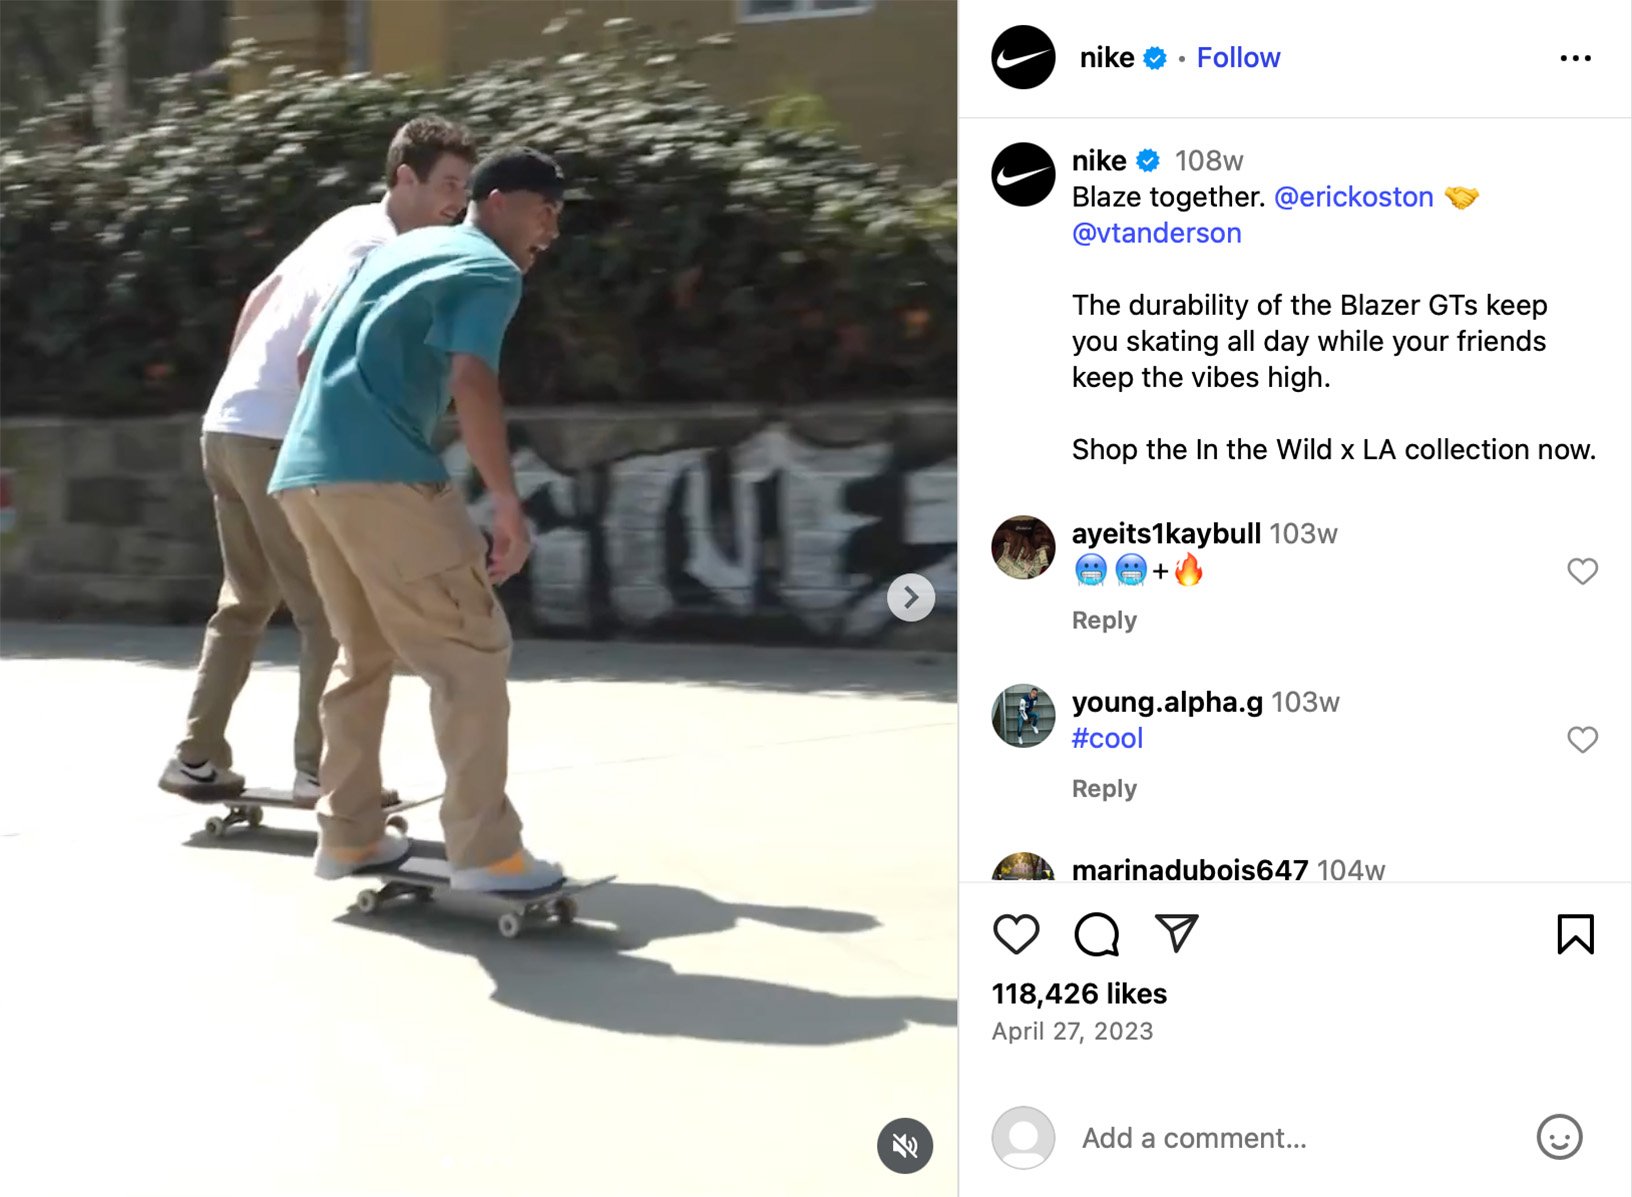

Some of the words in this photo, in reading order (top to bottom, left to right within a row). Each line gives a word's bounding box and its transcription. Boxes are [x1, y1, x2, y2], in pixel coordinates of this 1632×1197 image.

[1081, 45, 1135, 68] nike
[1198, 46, 1281, 68] Follow
[1073, 148, 1127, 171] nike
[1176, 150, 1243, 171] 108w
[1073, 185, 1141, 207] Blaze
[1150, 185, 1264, 212] together.
[1275, 185, 1433, 210] @erickoston
[1073, 221, 1241, 246] @vtanderson
[1072, 293, 1120, 315] The
[1129, 293, 1249, 320] durability
[1258, 293, 1282, 315] of
[1290, 293, 1331, 315] the
[1342, 293, 1421, 315] Blazer
[1429, 294, 1477, 316] GTs
[1487, 293, 1547, 320] keep
[1072, 335, 1117, 356] you
[1127, 329, 1218, 356] skating
[1228, 330, 1254, 351] all
[1264, 330, 1309, 356] day
[1318, 329, 1383, 351] while
[1392, 335, 1449, 356] your
[1457, 329, 1546, 351] friends
[1073, 366, 1133, 392] keep
[1142, 366, 1183, 388] the
[1192, 366, 1259, 388] vibes
[1269, 366, 1330, 392] high.
[1073, 438, 1137, 464] Shop
[1146, 438, 1187, 460] the
[1197, 439, 1217, 459] In
[1226, 438, 1267, 460] the
[1276, 438, 1331, 460] Wild
[1341, 444, 1354, 459] x
[1364, 439, 1396, 459] LA
[1405, 438, 1529, 460] collection
[1539, 443, 1595, 460] now.
[1072, 521, 1260, 549] ayeits1kaybull
[1270, 523, 1338, 544] 103w
[1073, 610, 1137, 633] Reply
[1072, 690, 1262, 717] young.alpha.g
[1273, 691, 1340, 712] 103w
[1072, 727, 1142, 748] #cool
[1073, 779, 1137, 802] Reply
[1073, 858, 1308, 880] marinadubois647
[1318, 859, 1385, 880] 104w
[993, 983, 1098, 1009] 118,426
[1108, 981, 1167, 1004] likes
[992, 1021, 1043, 1044] April
[1054, 1022, 1084, 1044] 27,
[1095, 1022, 1153, 1040] 2023
[1083, 1127, 1132, 1148] Add
[1142, 1132, 1155, 1148] a
